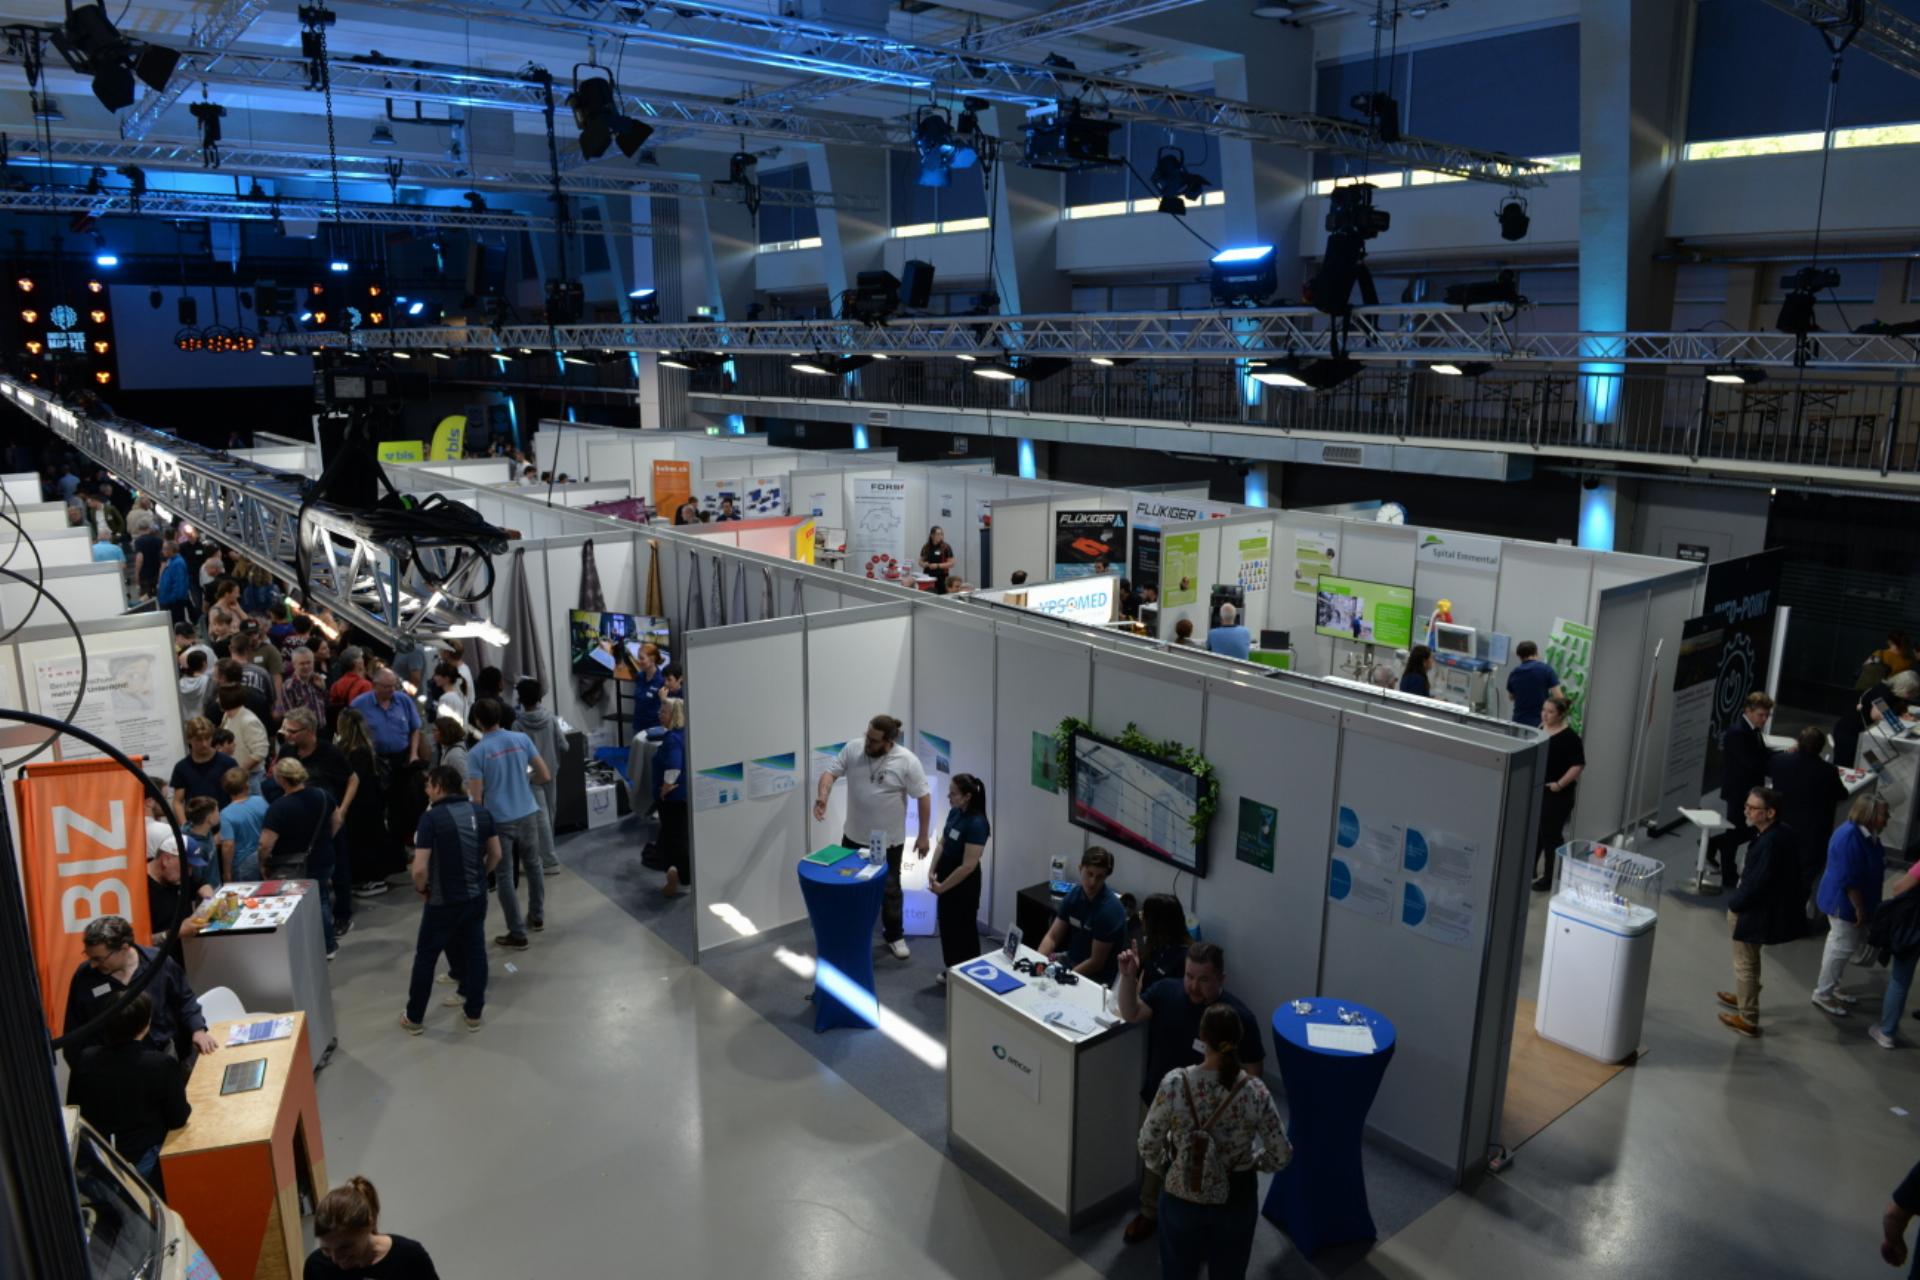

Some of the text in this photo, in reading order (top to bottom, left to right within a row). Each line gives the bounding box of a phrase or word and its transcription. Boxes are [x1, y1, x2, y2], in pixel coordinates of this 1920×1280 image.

[1433, 548, 1498, 565] Spital Emmental
[52, 800, 133, 934] BIZ
